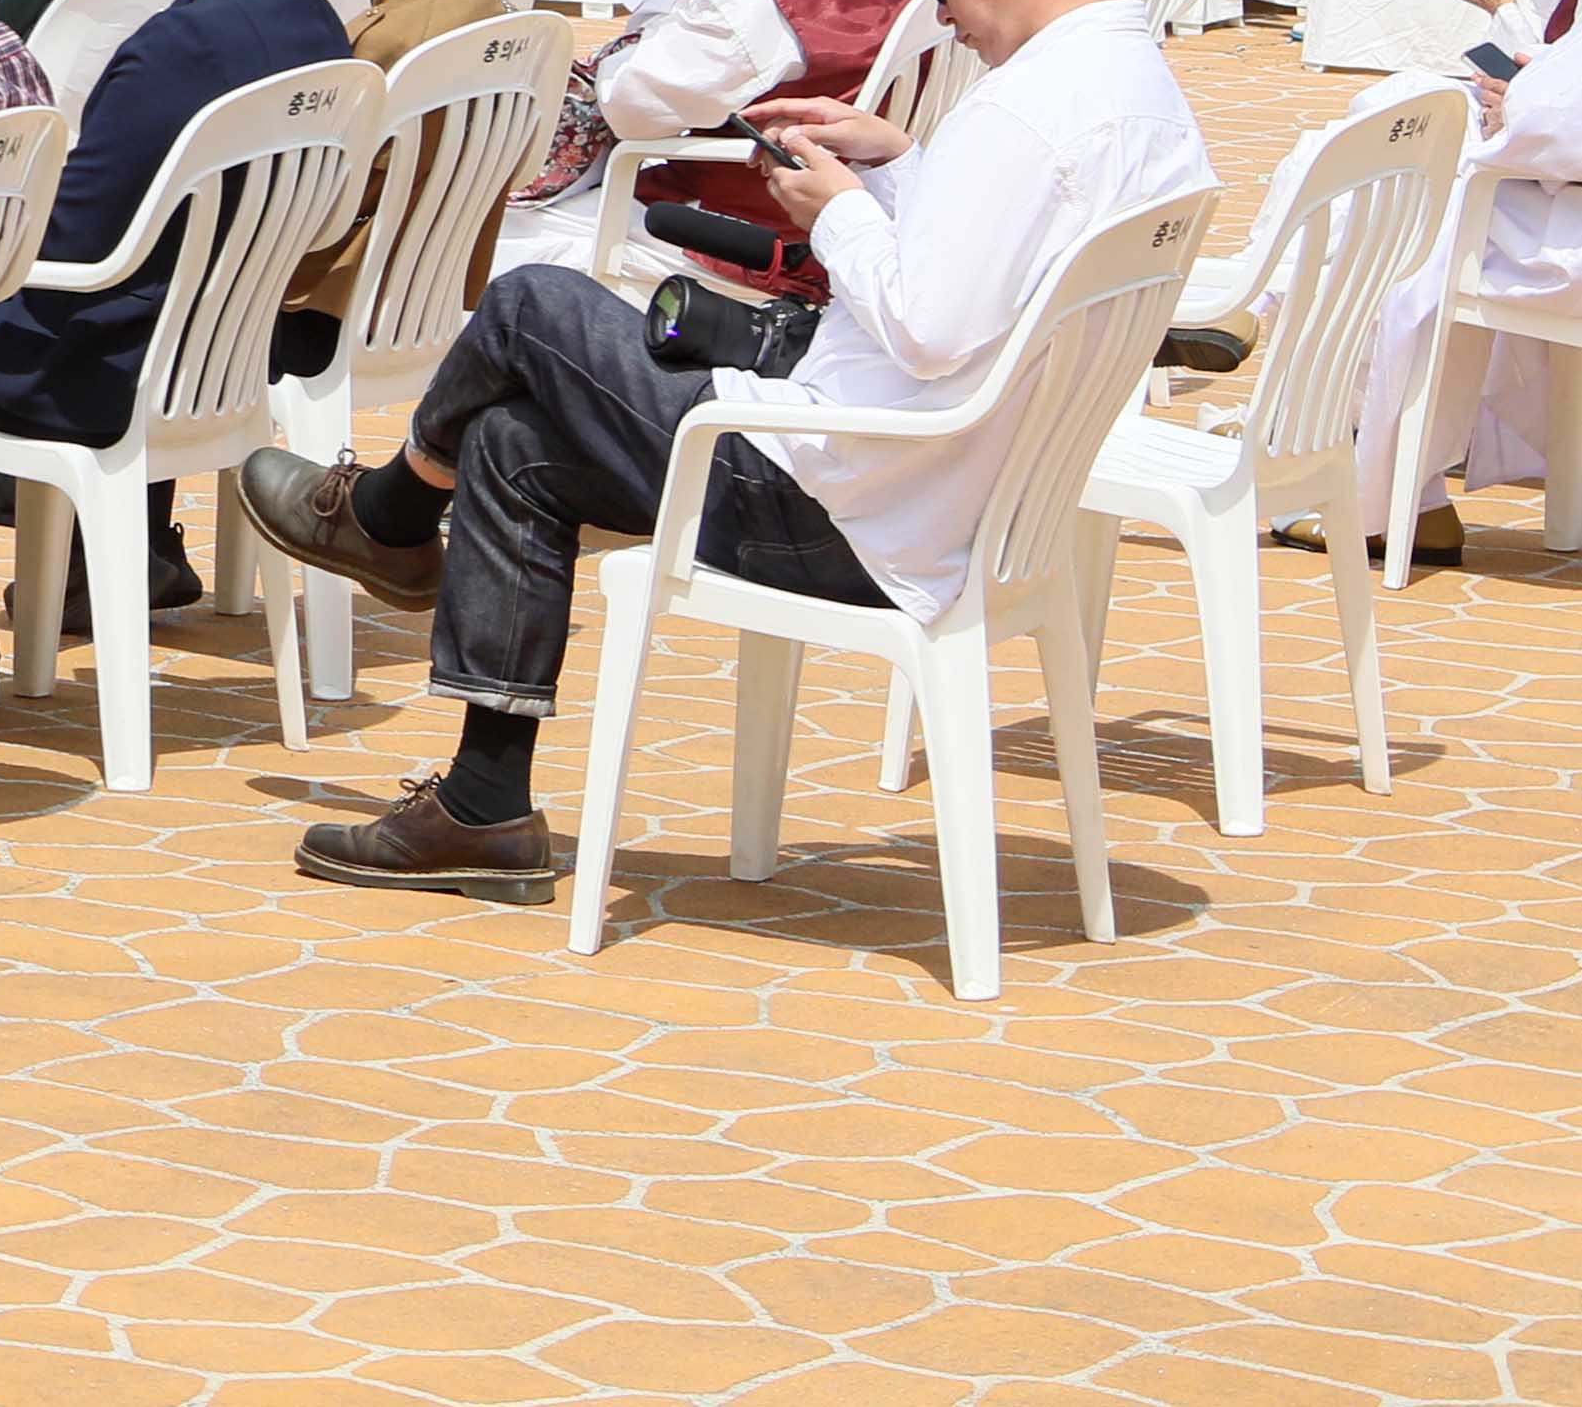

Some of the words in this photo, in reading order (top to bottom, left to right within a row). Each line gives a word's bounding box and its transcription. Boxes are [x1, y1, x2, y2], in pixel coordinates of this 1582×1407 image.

[482, 38, 529, 65] 충의사
[287, 87, 340, 117] 충의사
[1388, 113, 1431, 143] 충의사
[1152, 216, 1191, 248] 충의사
